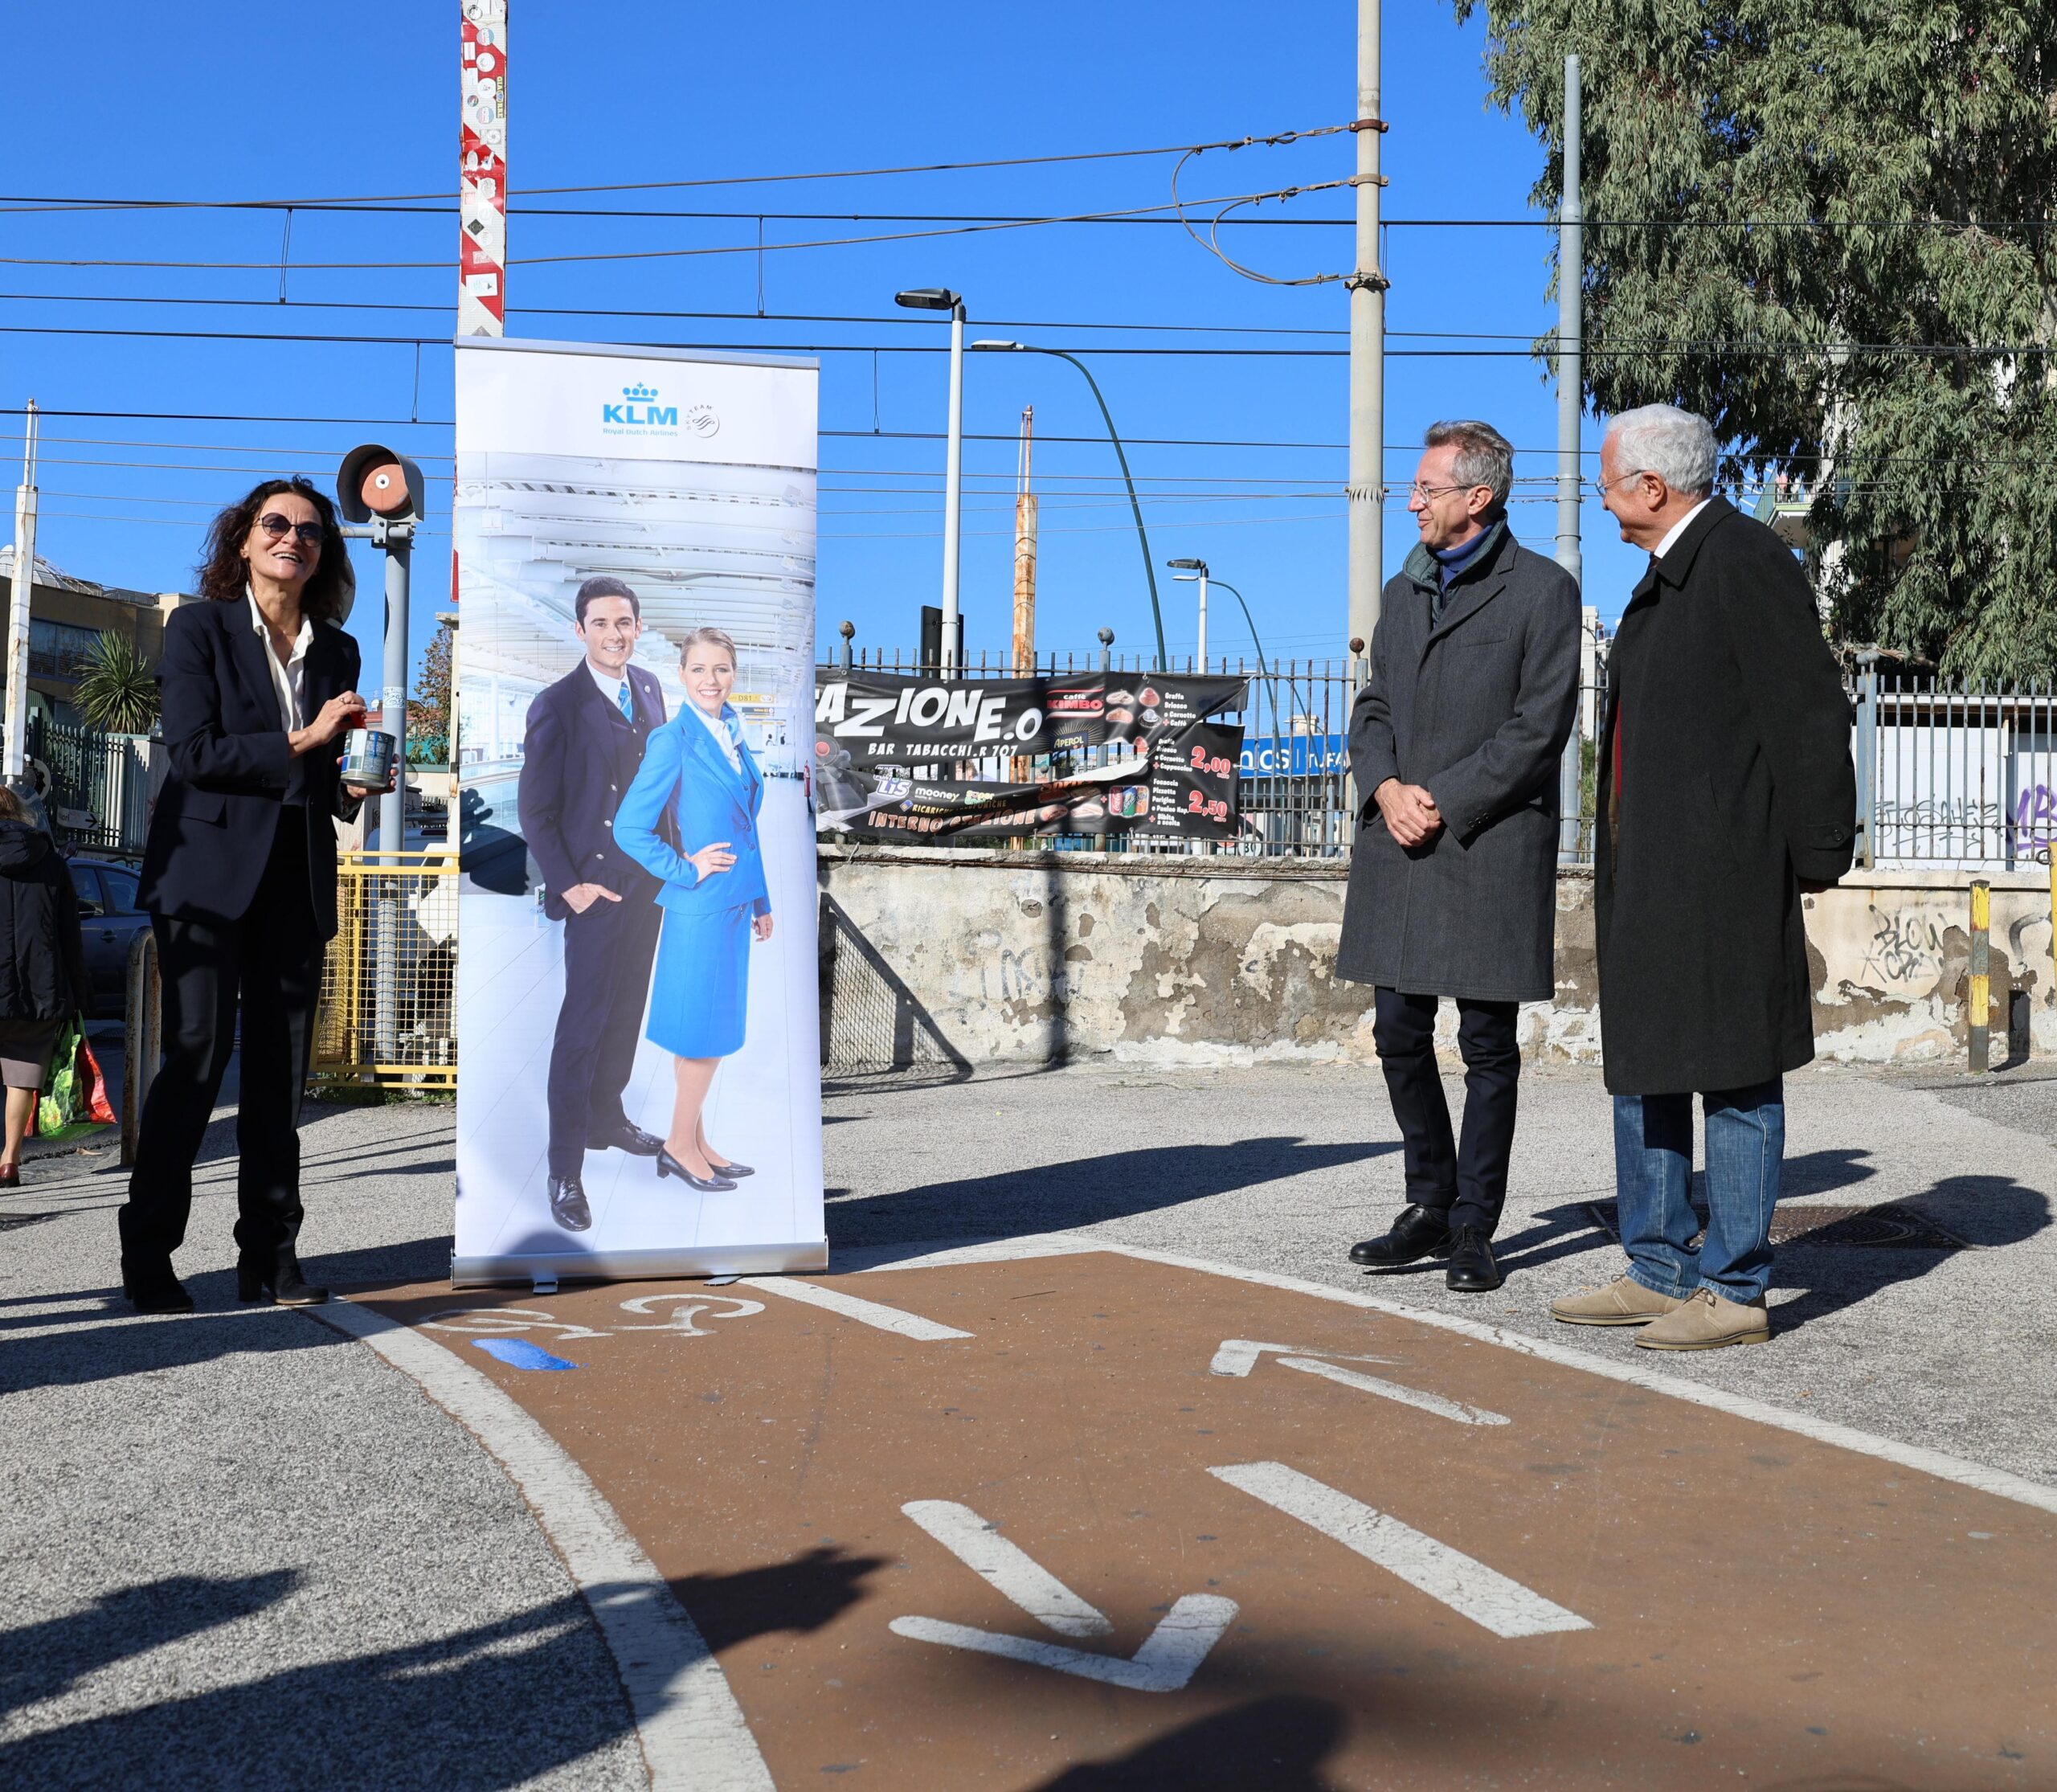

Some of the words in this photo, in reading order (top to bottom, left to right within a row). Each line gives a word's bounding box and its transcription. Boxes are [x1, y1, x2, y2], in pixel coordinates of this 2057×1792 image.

[603, 404, 677, 426] KLM
[686, 404, 714, 432] SKYTEAM
[603, 428, 624, 436] Royal
[1165, 692, 1184, 700] Graffa
[1046, 699, 1103, 710] KIMBO
[1053, 736, 1084, 749] APEROL
[868, 743, 895, 755] BAR
[992, 744, 1019, 756] 707
[1159, 754, 1185, 763] Cornetto
[1190, 745, 1231, 774] 2,00
[1160, 763, 1192, 771] Cappuccino
[1153, 778, 1179, 787] Focaccia
[915, 788, 960, 802] mooney
[1188, 789, 1228, 817] 2,50
[868, 811, 944, 833] INTERNO
